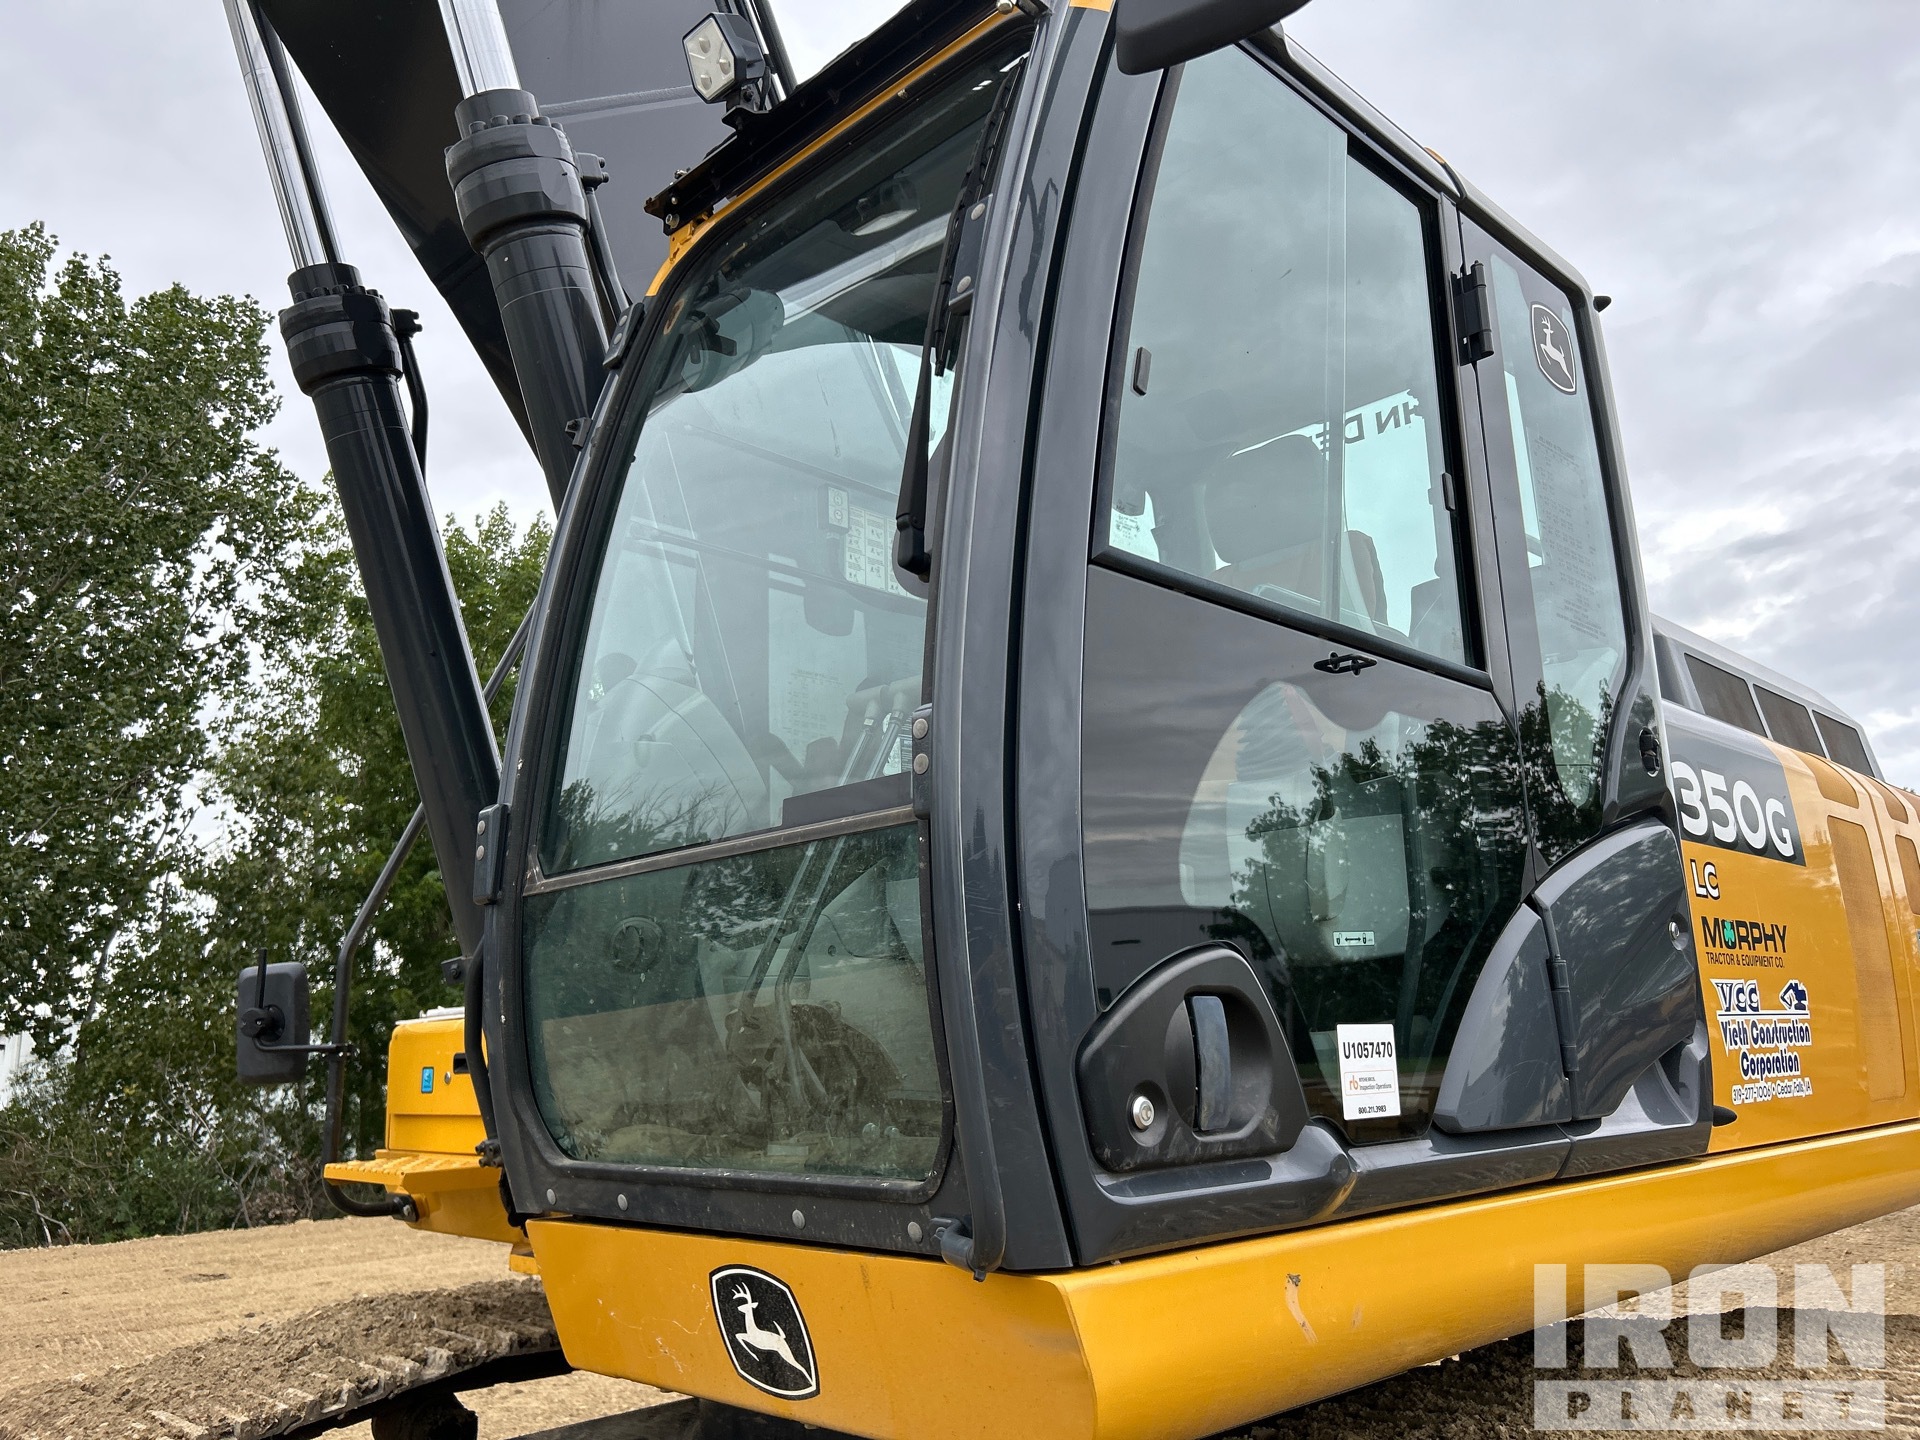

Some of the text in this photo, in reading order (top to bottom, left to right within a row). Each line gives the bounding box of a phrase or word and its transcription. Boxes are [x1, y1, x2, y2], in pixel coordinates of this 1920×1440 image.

[1671, 761, 1796, 861] 350G
[1690, 859, 1720, 900] LC
[1701, 916, 1787, 953] MURPHY
[1706, 952, 1735, 966] TRACTOR
[1741, 954, 1773, 968] EQUIPMENT
[1774, 956, 1785, 968] CO.
[1714, 982, 1760, 1012] VCC
[1721, 1019, 1810, 1047] Vieth Construction
[1343, 1041, 1393, 1060] U1057470
[1741, 1049, 1799, 1081] Corporation
[1776, 1082, 1792, 1095] Cedar
